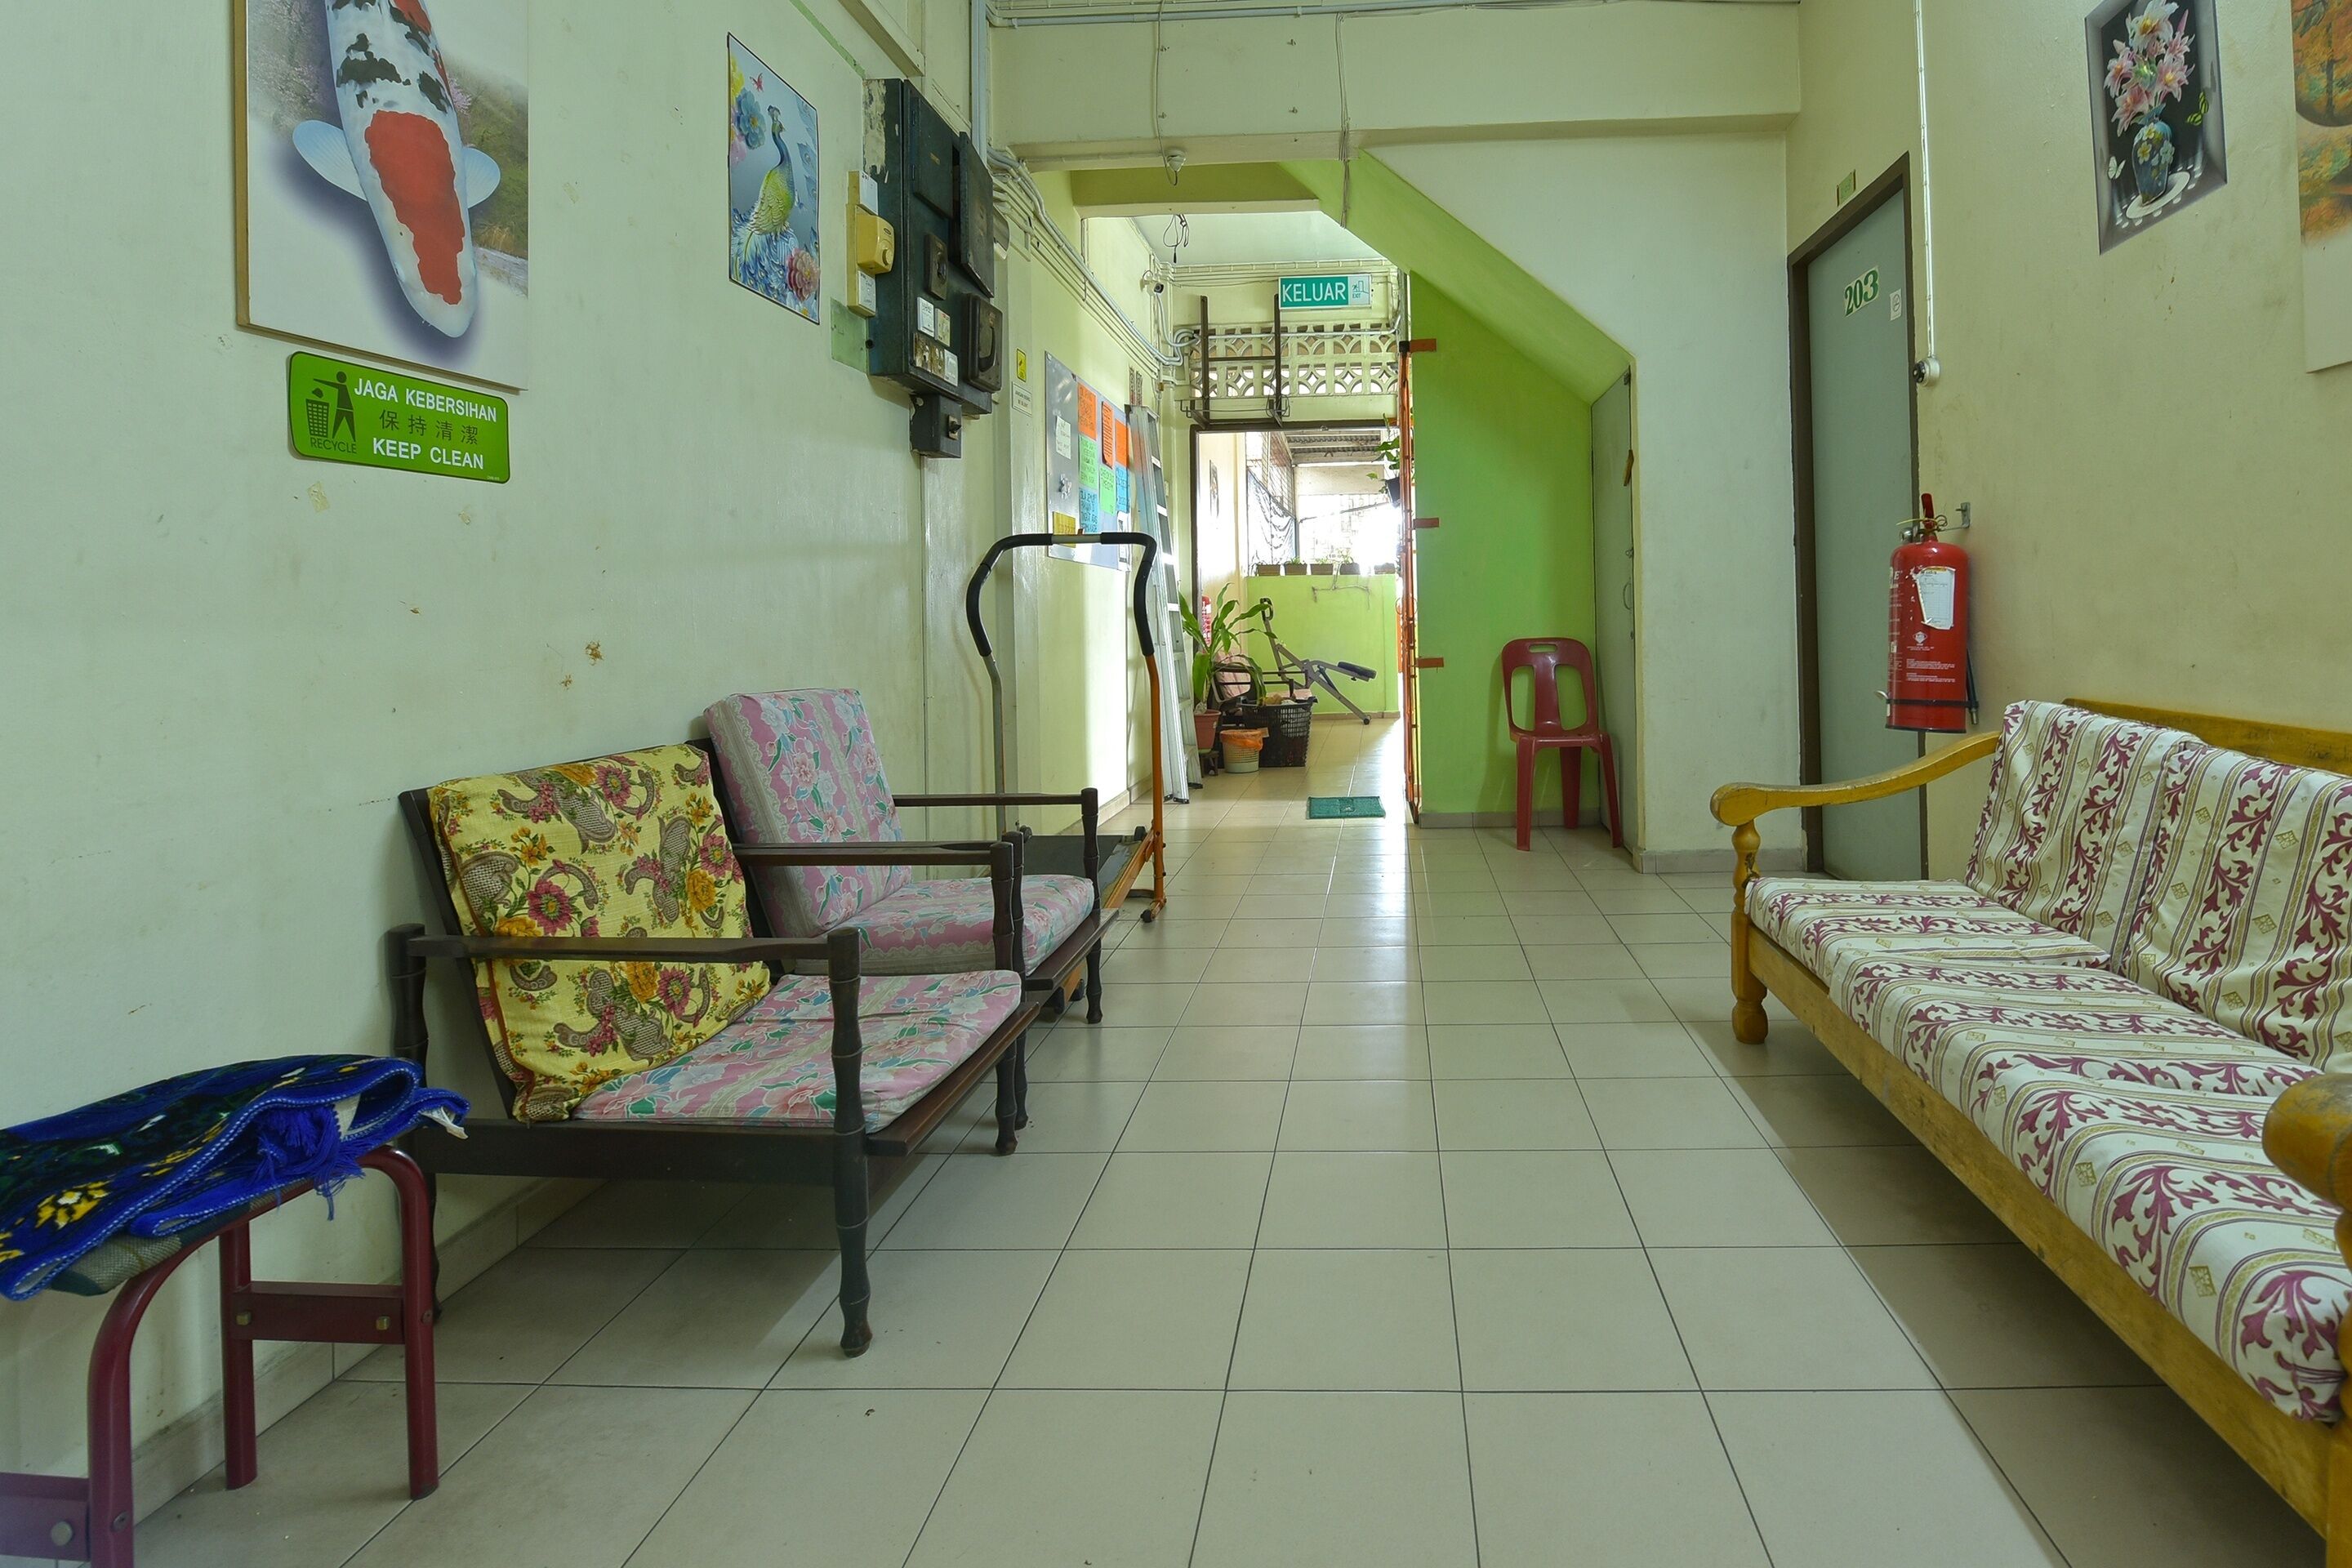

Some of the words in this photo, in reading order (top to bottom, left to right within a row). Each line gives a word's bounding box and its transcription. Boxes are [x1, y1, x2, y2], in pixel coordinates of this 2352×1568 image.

[1282, 282, 1346, 302] KELUAR
[1845, 270, 1879, 316] 203
[354, 377, 399, 403] JAGA
[405, 388, 497, 422] KEBERSIHAN
[379, 408, 479, 445] 保持清潔
[310, 436, 357, 454] RECYCLE
[372, 437, 421, 460] KEEP
[430, 447, 483, 470] CLEAN
